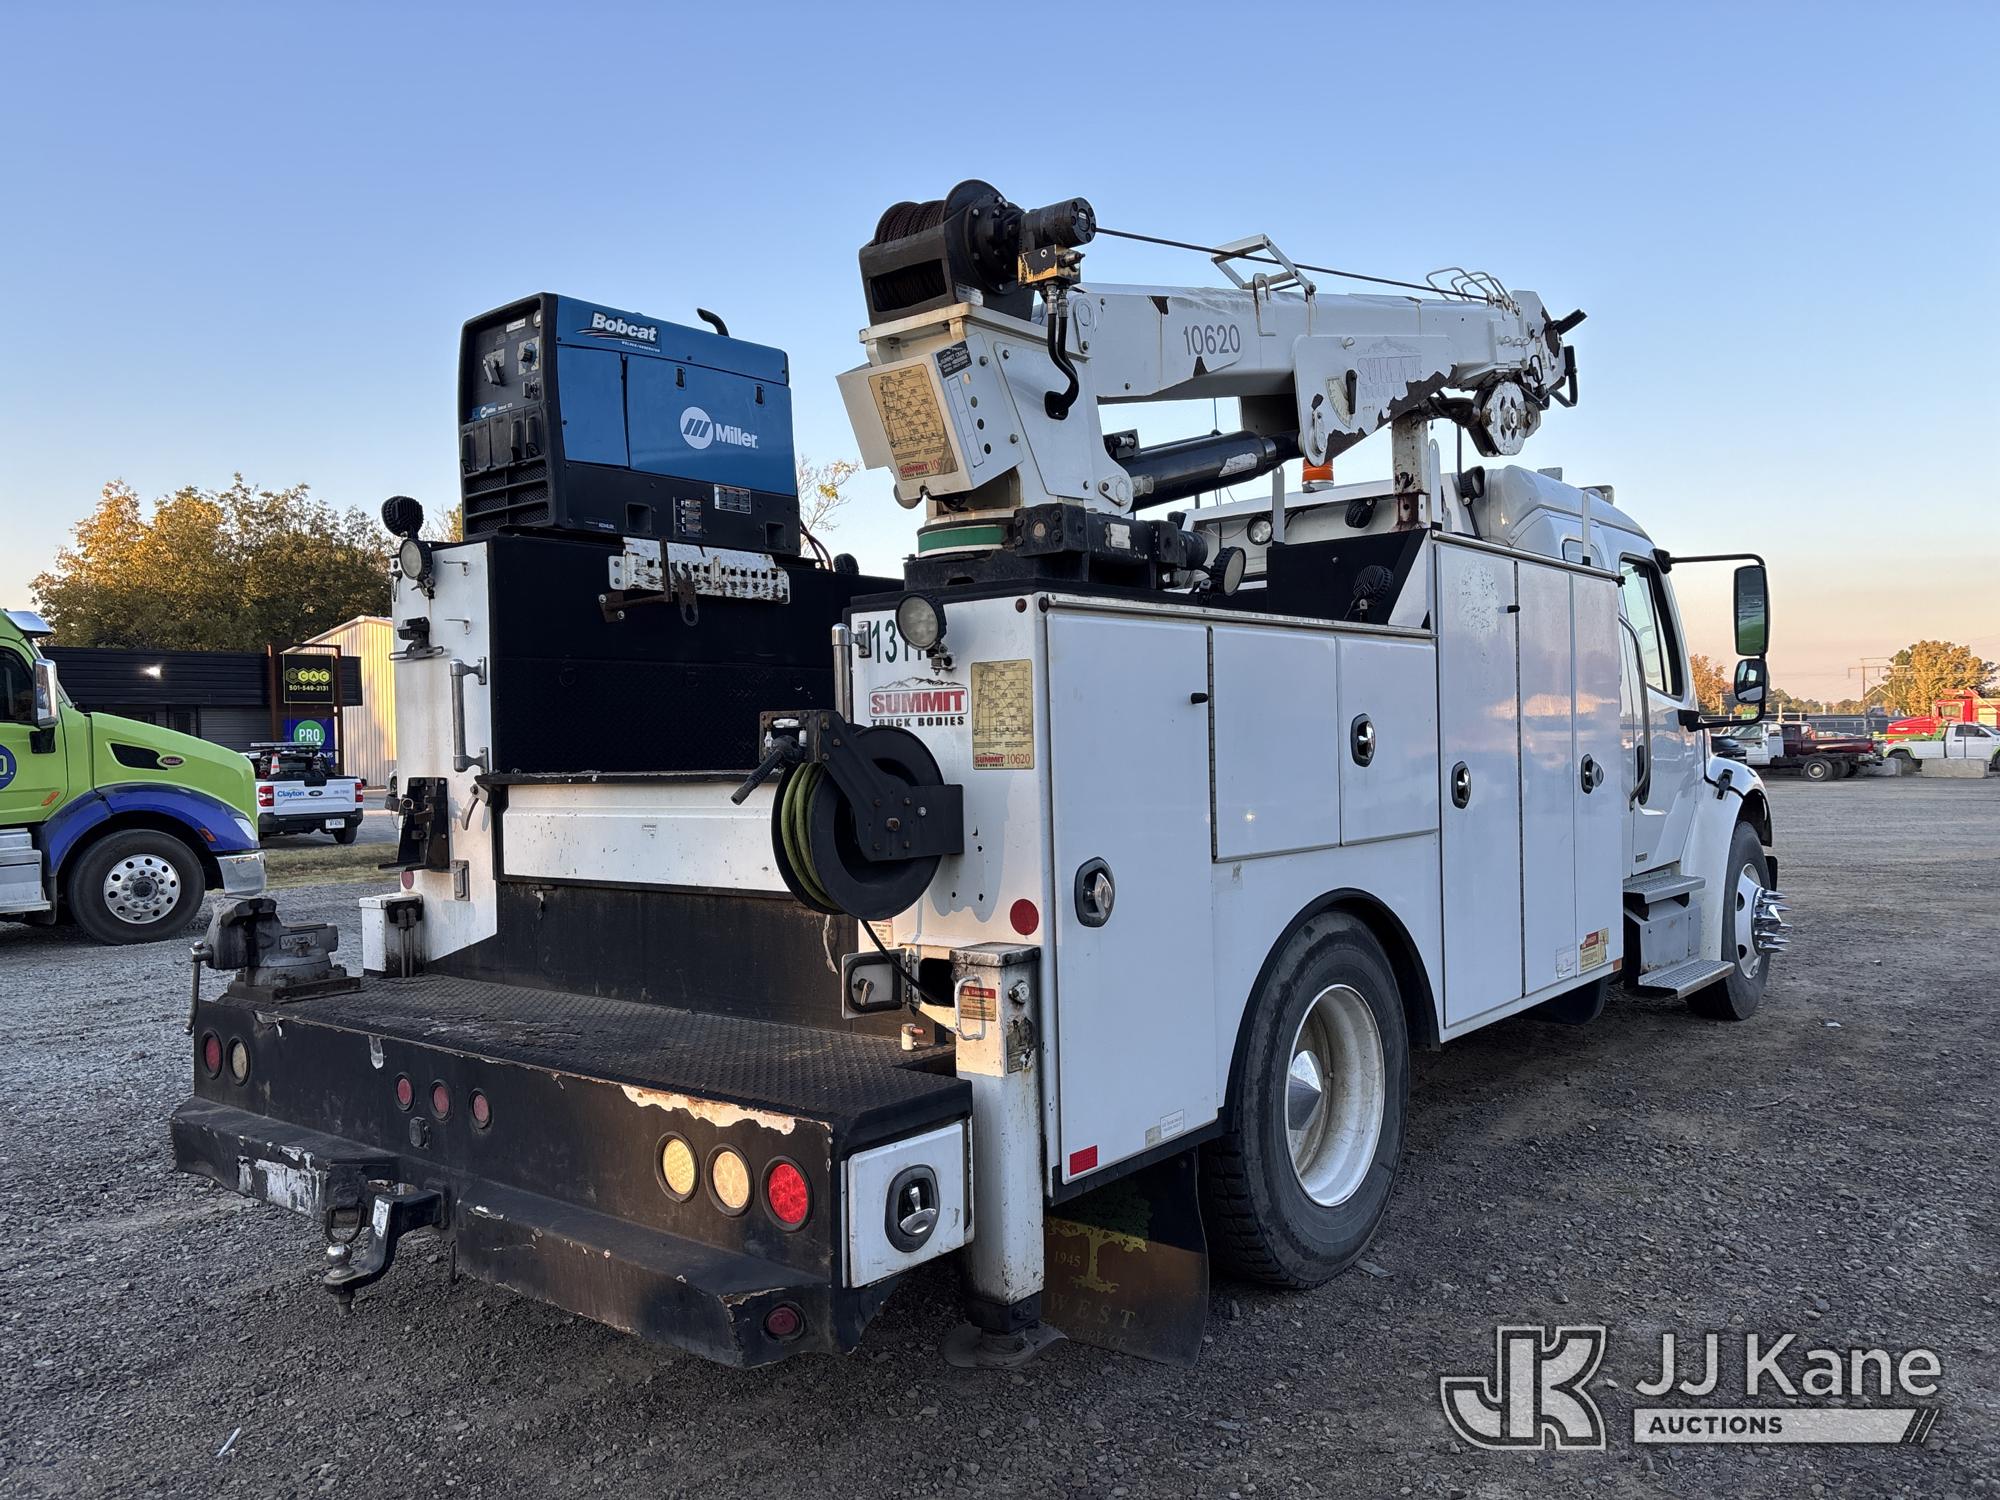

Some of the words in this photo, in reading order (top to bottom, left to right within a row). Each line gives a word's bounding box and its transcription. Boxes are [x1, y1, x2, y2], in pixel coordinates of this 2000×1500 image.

[592, 313, 657, 341] Bobcat
[1183, 324, 1240, 356] 10620
[900, 463, 929, 475] SUMMIT
[871, 690, 966, 715] SUMMIT
[871, 717, 912, 728] TRUCK
[917, 716, 965, 727] BODIES
[975, 755, 1004, 764] SUMMIT
[1006, 753, 1031, 765] 10620
[277, 790, 305, 799] Clayton
[1054, 1250, 1081, 1268] 1945
